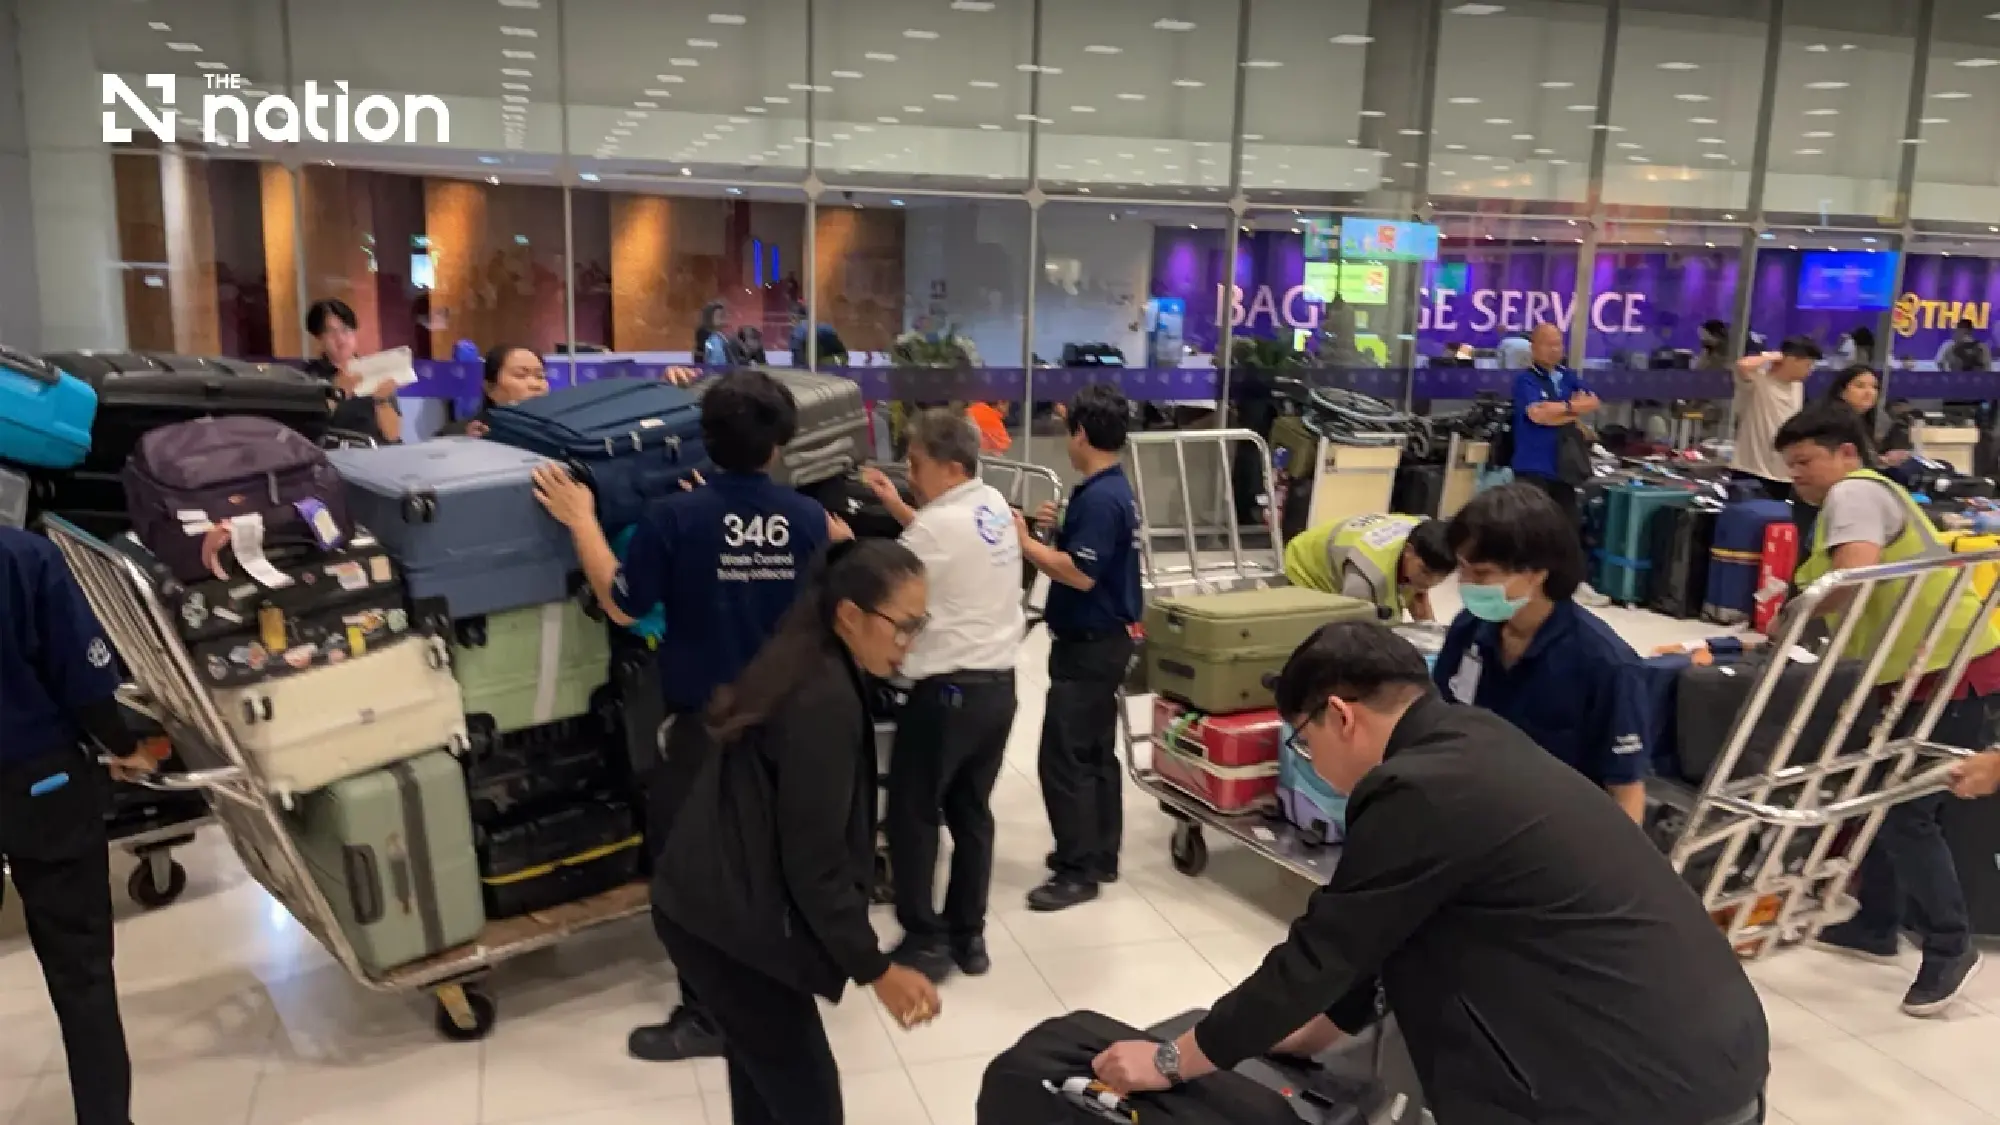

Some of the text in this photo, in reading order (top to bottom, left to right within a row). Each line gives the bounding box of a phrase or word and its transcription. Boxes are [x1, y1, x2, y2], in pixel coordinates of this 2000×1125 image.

[1215, 282, 1647, 333] BAGE SERVCE
[1919, 299, 1991, 330] THAI
[723, 513, 790, 547] 346
